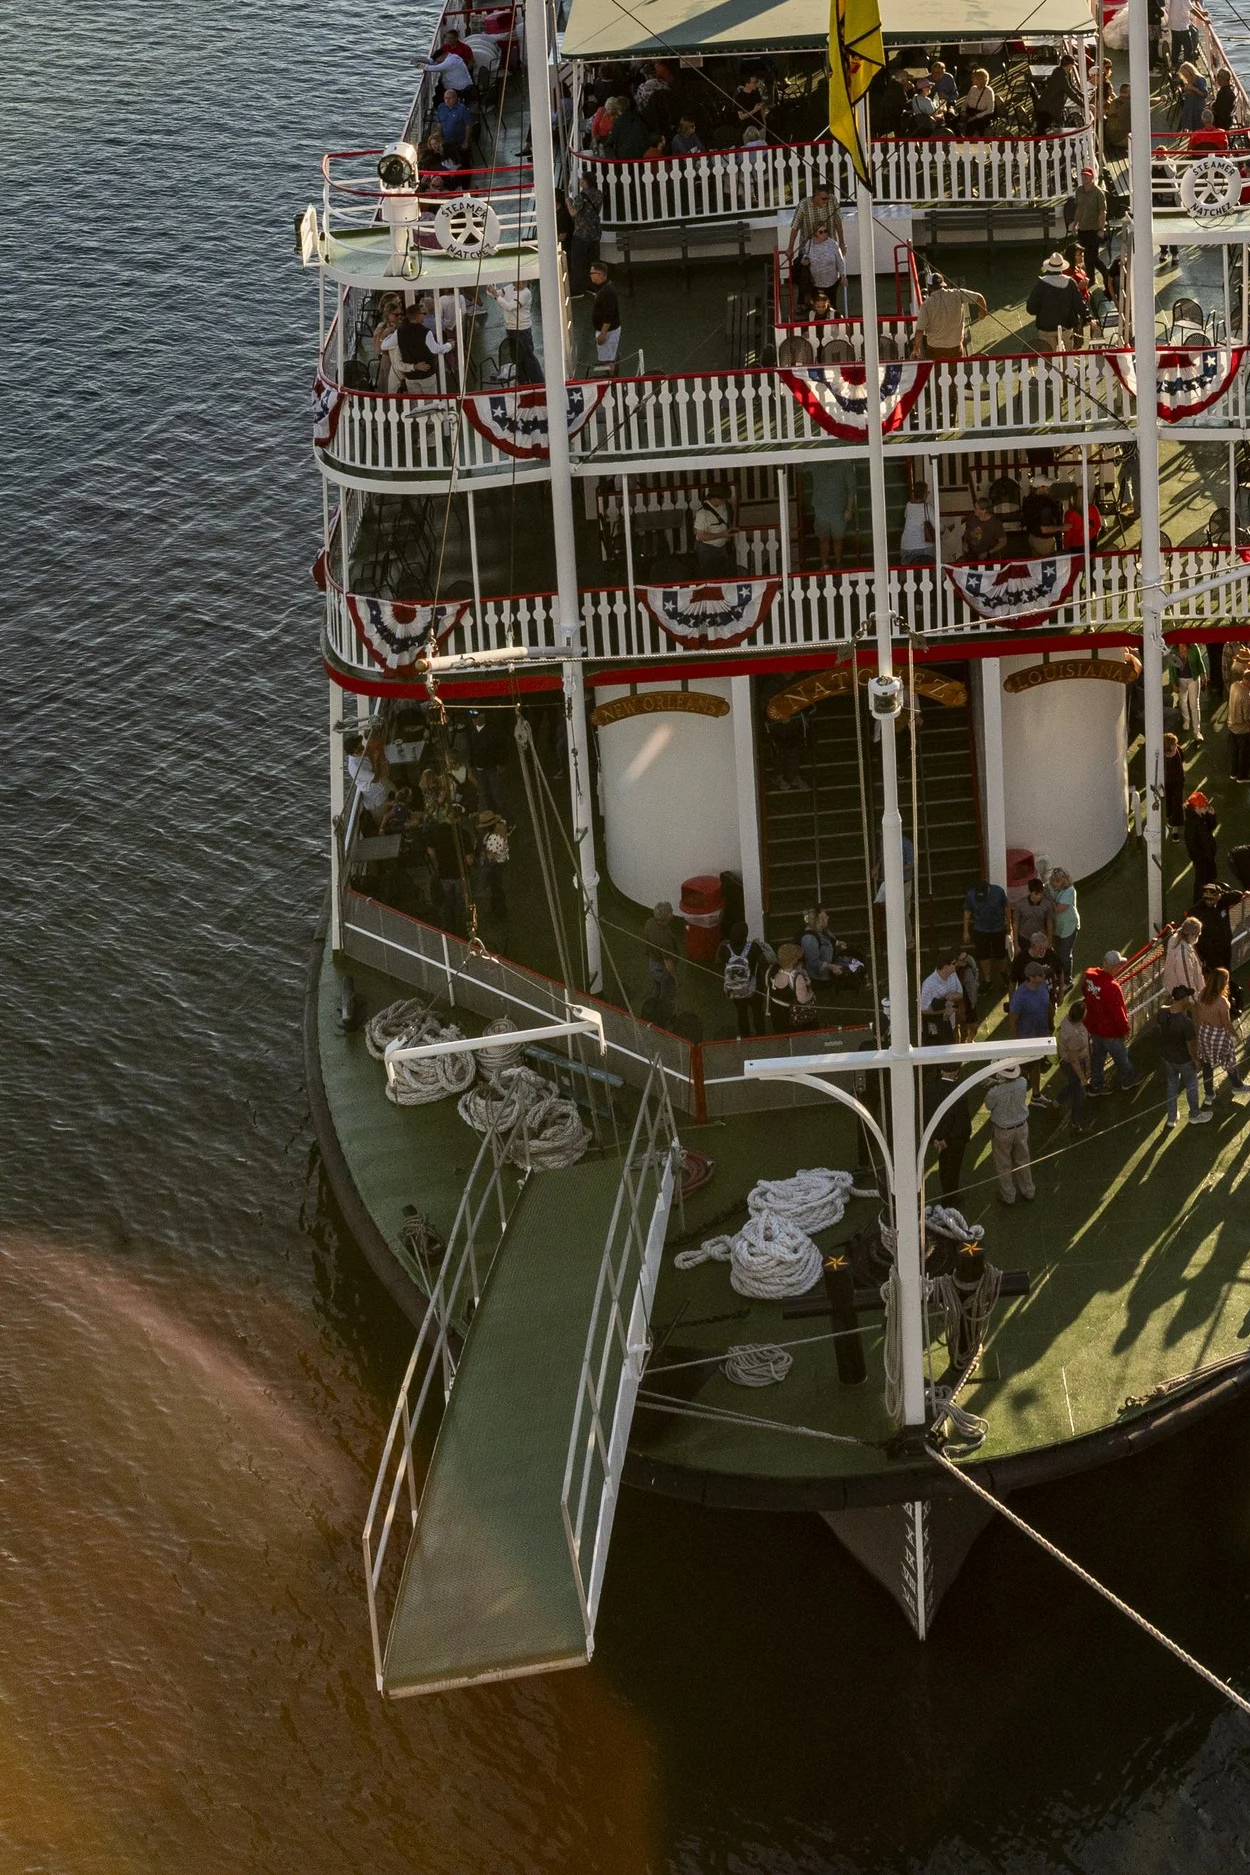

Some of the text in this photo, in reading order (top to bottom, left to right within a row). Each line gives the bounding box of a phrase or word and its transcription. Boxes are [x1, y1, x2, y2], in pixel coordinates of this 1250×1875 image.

[1192, 161, 1236, 177] STEAMER
[441, 202, 488, 219] STEAMER
[1190, 202, 1232, 217] NATCHEZ
[1015, 663, 1123, 688] LOUISIANA
[784, 667, 950, 710] NATCEZ
[601, 694, 718, 720] NEW ORLEANS
